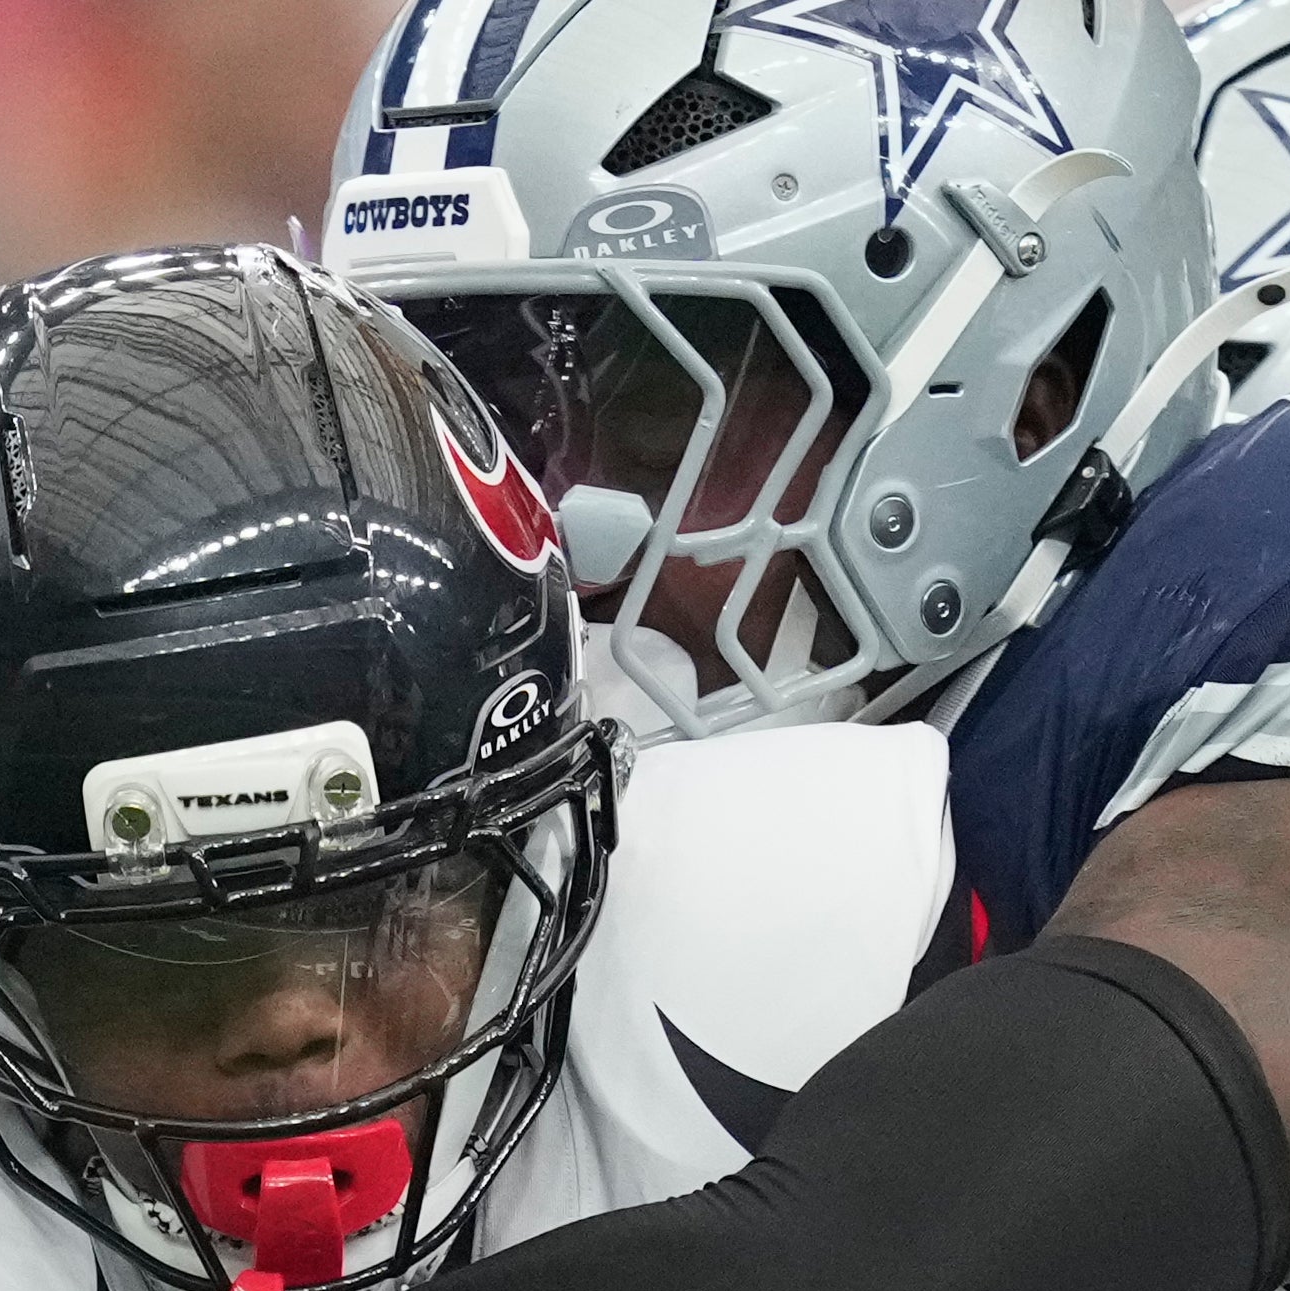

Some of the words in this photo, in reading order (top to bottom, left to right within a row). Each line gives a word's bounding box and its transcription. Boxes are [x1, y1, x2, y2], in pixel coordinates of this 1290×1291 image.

[344, 193, 470, 234] COWBOYS
[573, 224, 699, 260] OAKLEY
[480, 699, 551, 759] OAKLEY
[177, 790, 289, 808] TEXANS
